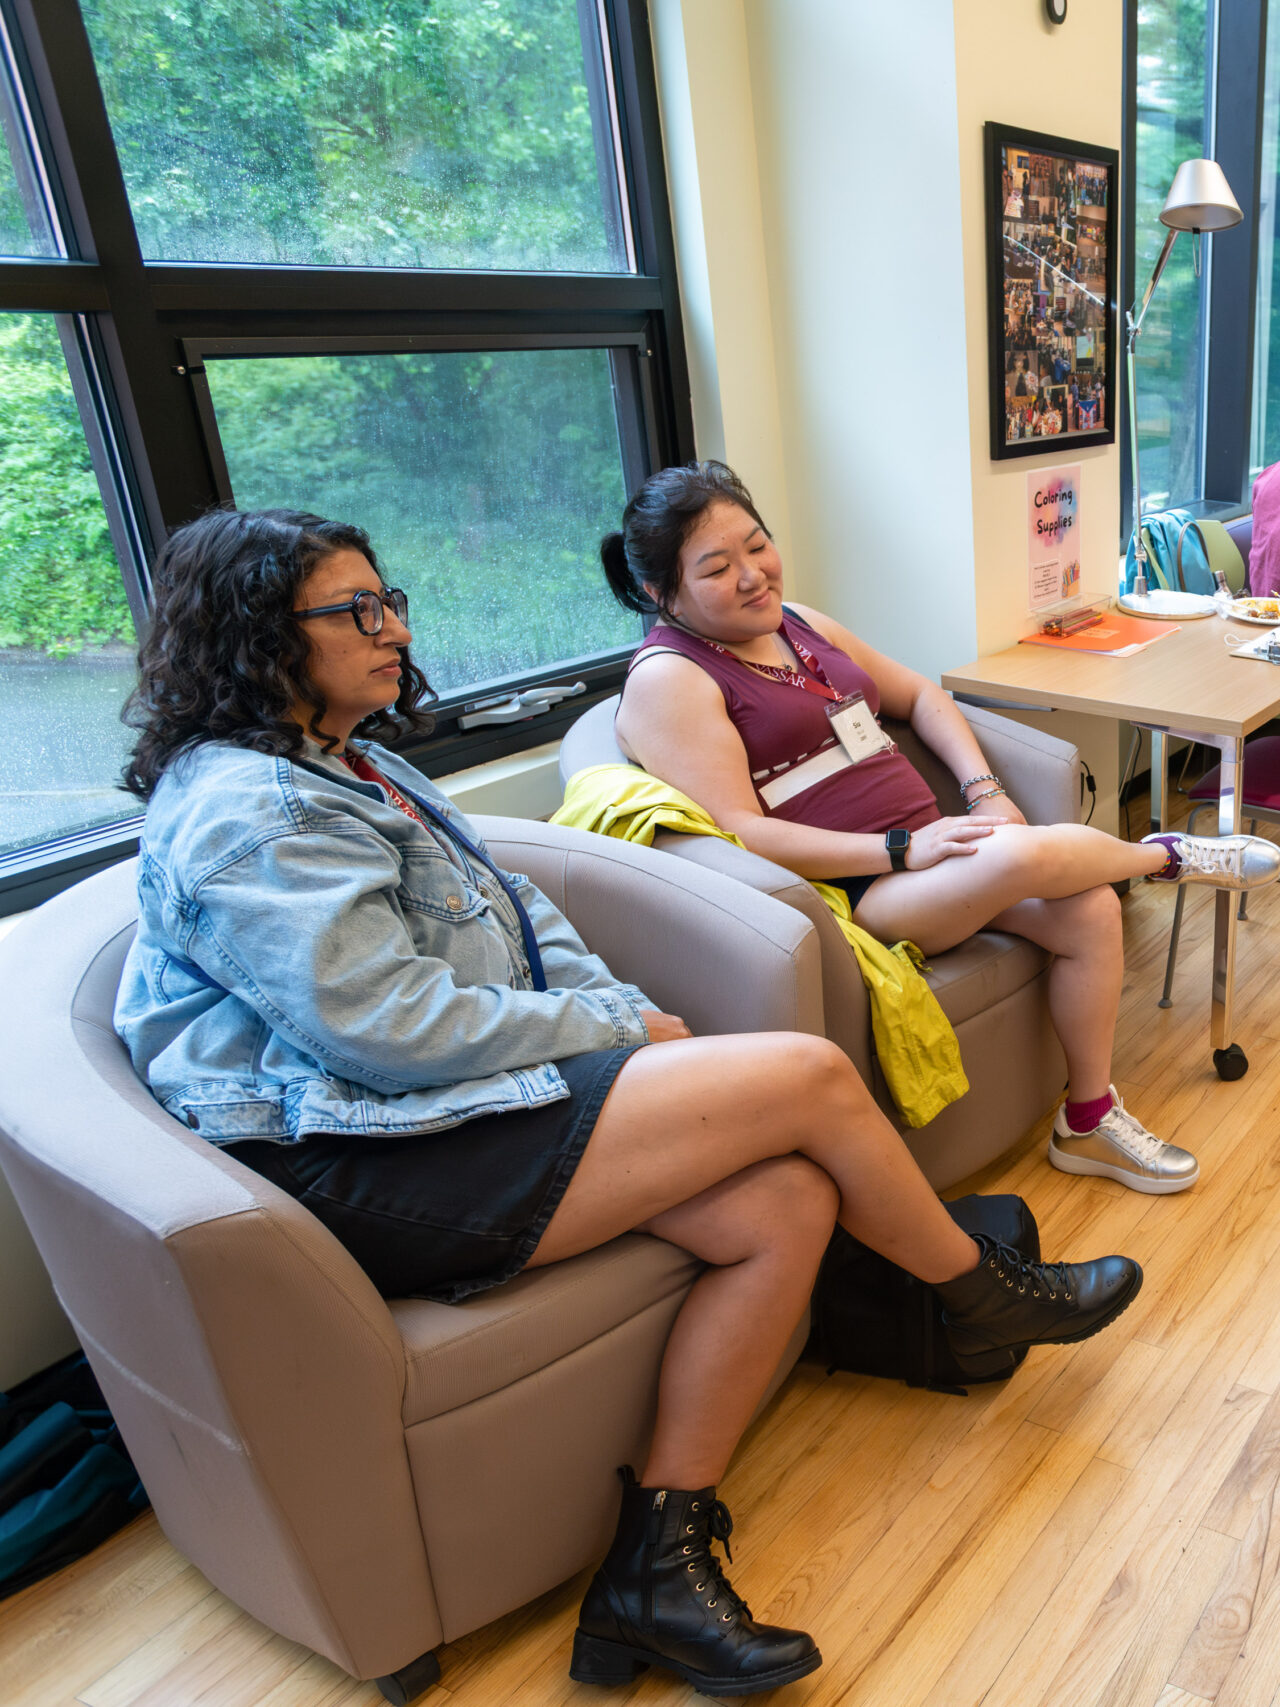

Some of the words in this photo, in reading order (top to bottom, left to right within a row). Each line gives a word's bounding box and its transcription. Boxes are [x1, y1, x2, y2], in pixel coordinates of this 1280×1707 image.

[1034, 488, 1073, 508] Coloring
[1036, 515, 1073, 537] Supplies
[754, 663, 806, 689] VASSAR
